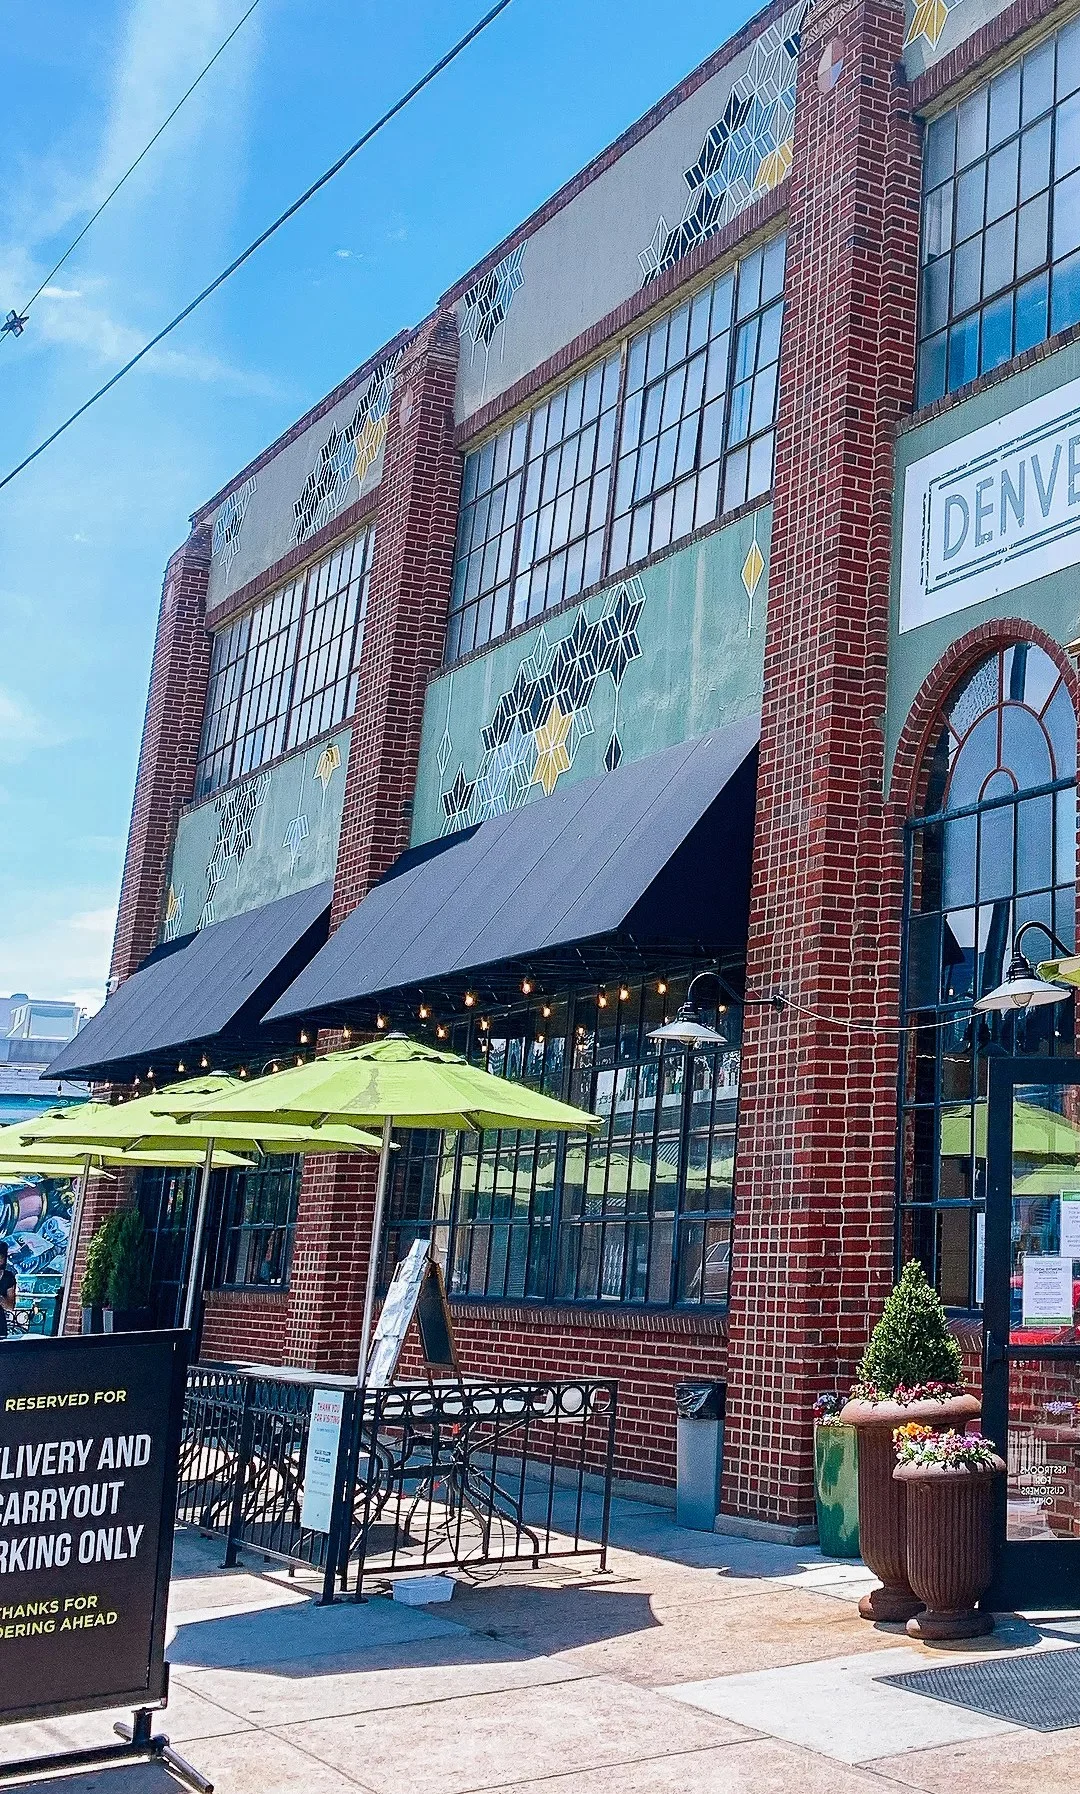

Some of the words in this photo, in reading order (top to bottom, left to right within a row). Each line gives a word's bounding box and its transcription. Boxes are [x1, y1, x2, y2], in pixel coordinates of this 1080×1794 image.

[5, 1395, 90, 1412] RESERVED
[94, 1390, 127, 1405] FOR
[0, 1439, 94, 1480] LIVERY
[97, 1434, 152, 1471] AND
[78, 1524, 145, 1564] ONLY
[0, 1600, 60, 1620] HANKS
[64, 1595, 98, 1612] FOR
[60, 1611, 118, 1632] AHEAD
